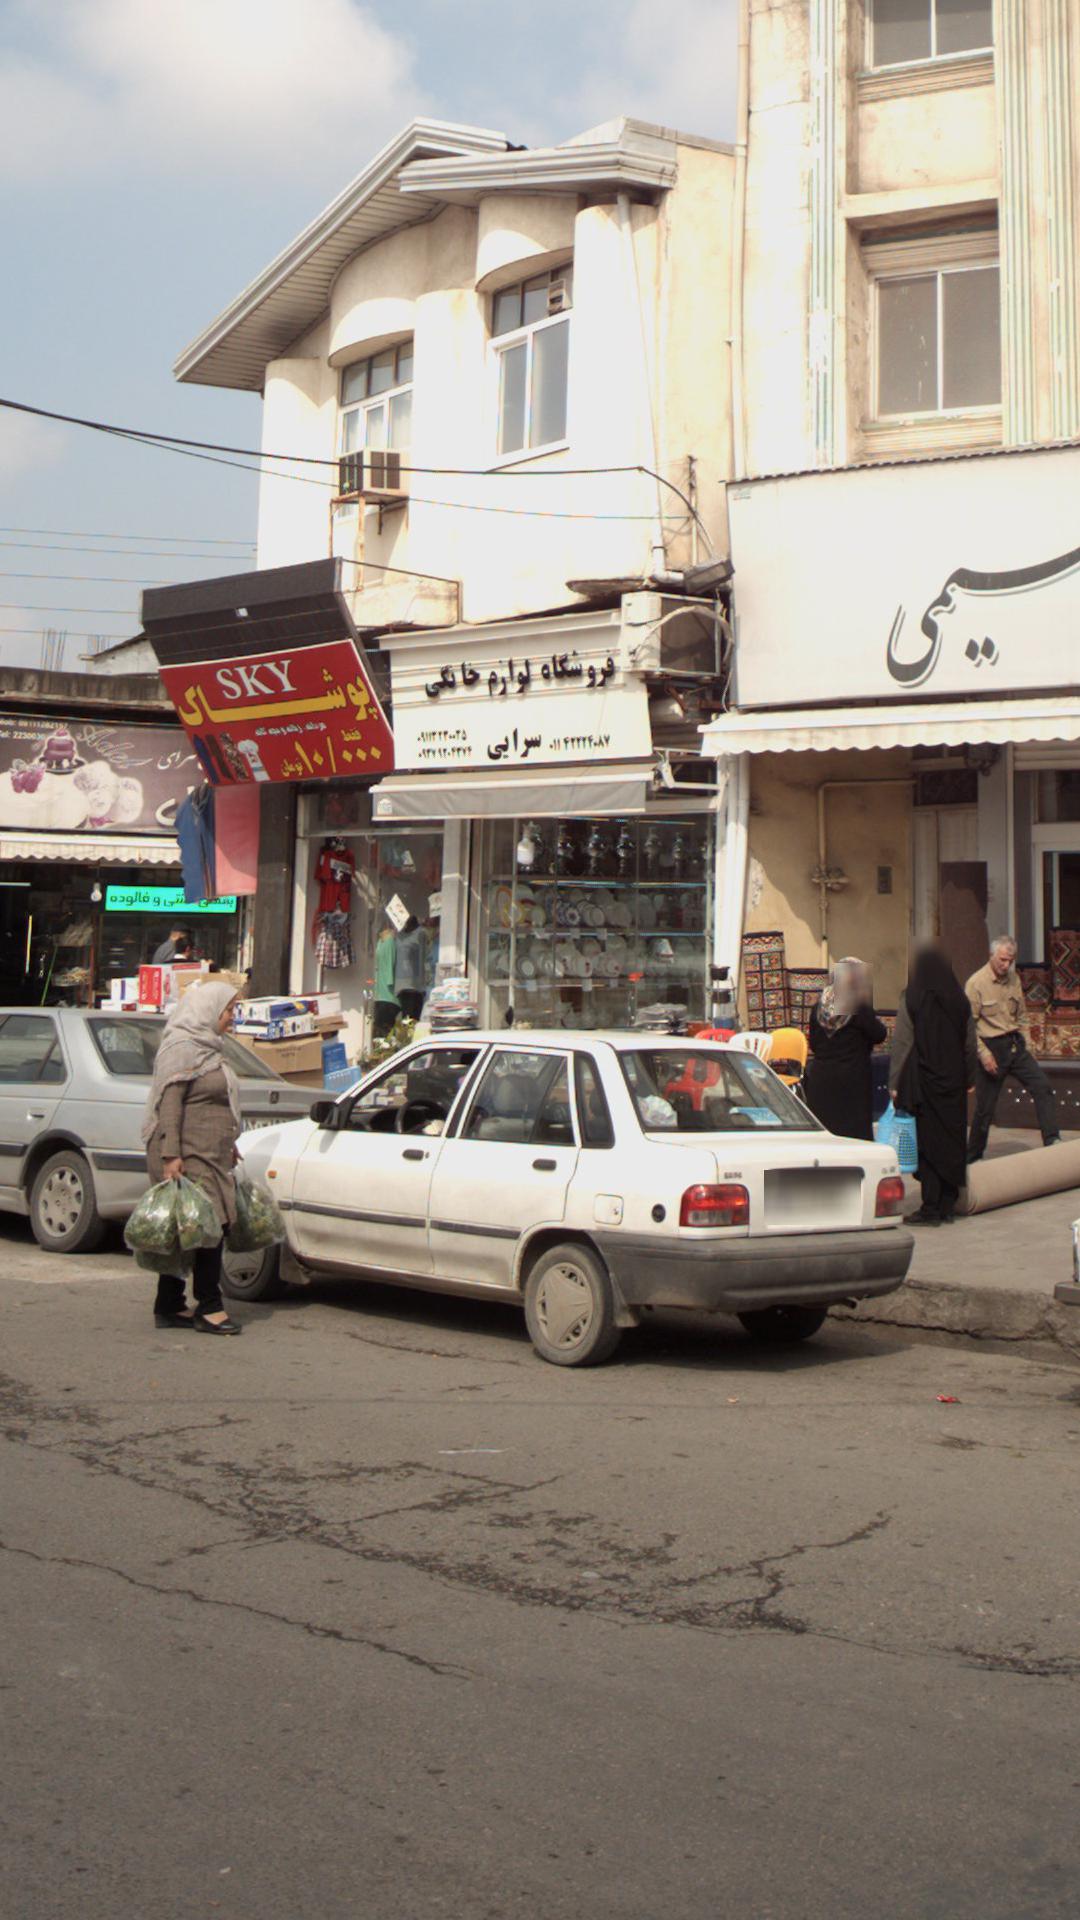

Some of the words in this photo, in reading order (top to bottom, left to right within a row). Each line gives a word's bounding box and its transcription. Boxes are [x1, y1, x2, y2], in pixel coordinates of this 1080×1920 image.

[216, 660, 297, 700] SKY
[425, 661, 481, 698] خانگی
[488, 659, 531, 696] لوازم
[542, 650, 615, 689] فروشگاه
[178, 668, 379, 726] پوشاک
[487, 728, 542, 760] سرایی
[110, 891, 150, 907] فالوده
